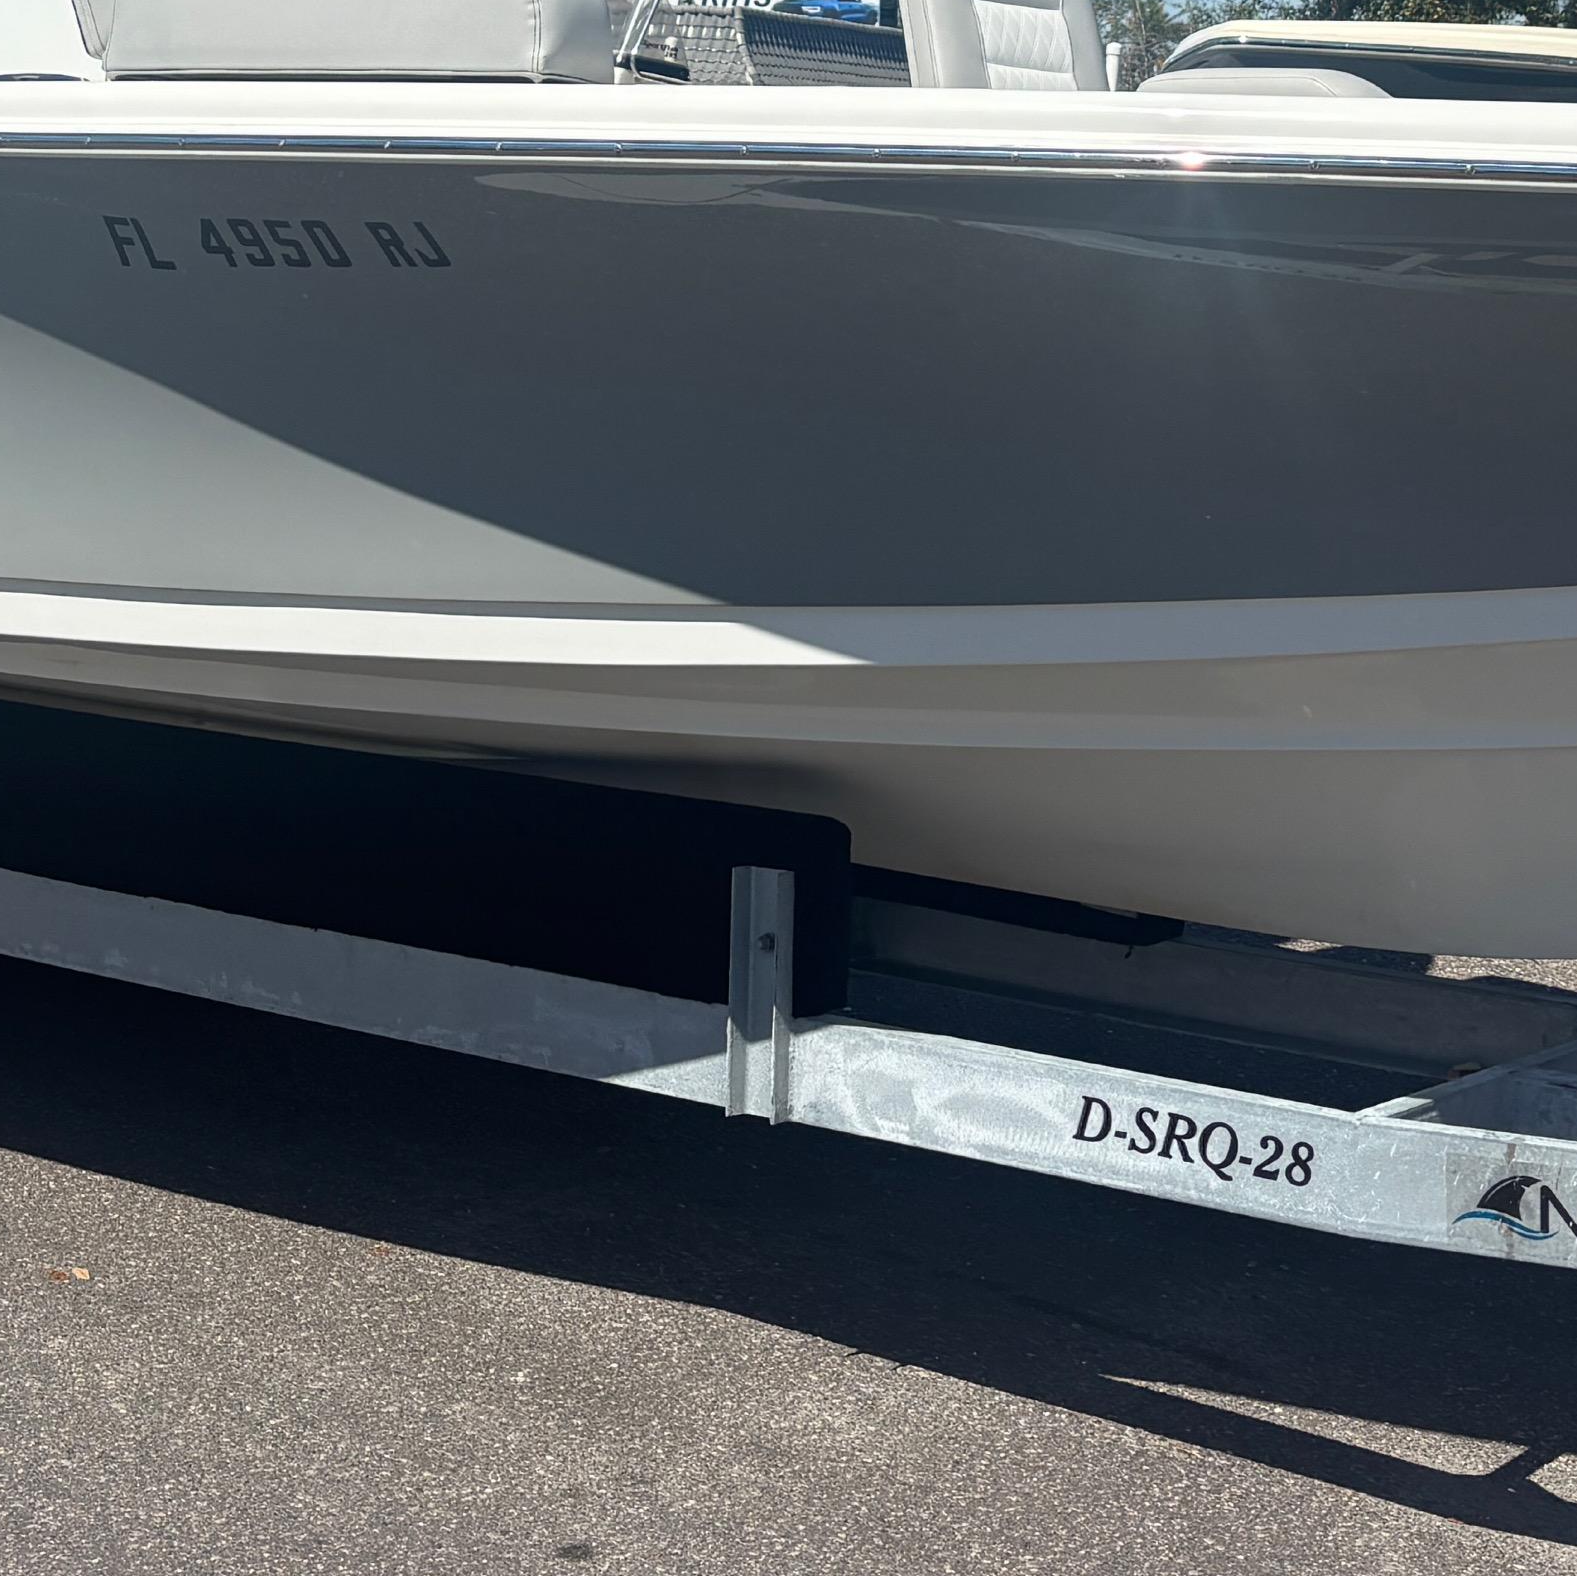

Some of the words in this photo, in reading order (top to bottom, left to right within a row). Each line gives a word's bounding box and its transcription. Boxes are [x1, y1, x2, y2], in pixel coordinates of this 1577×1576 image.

[102, 215, 178, 271] FL
[364, 221, 452, 268] RJ
[1072, 1095, 1314, 1187] D-SRQ-28
